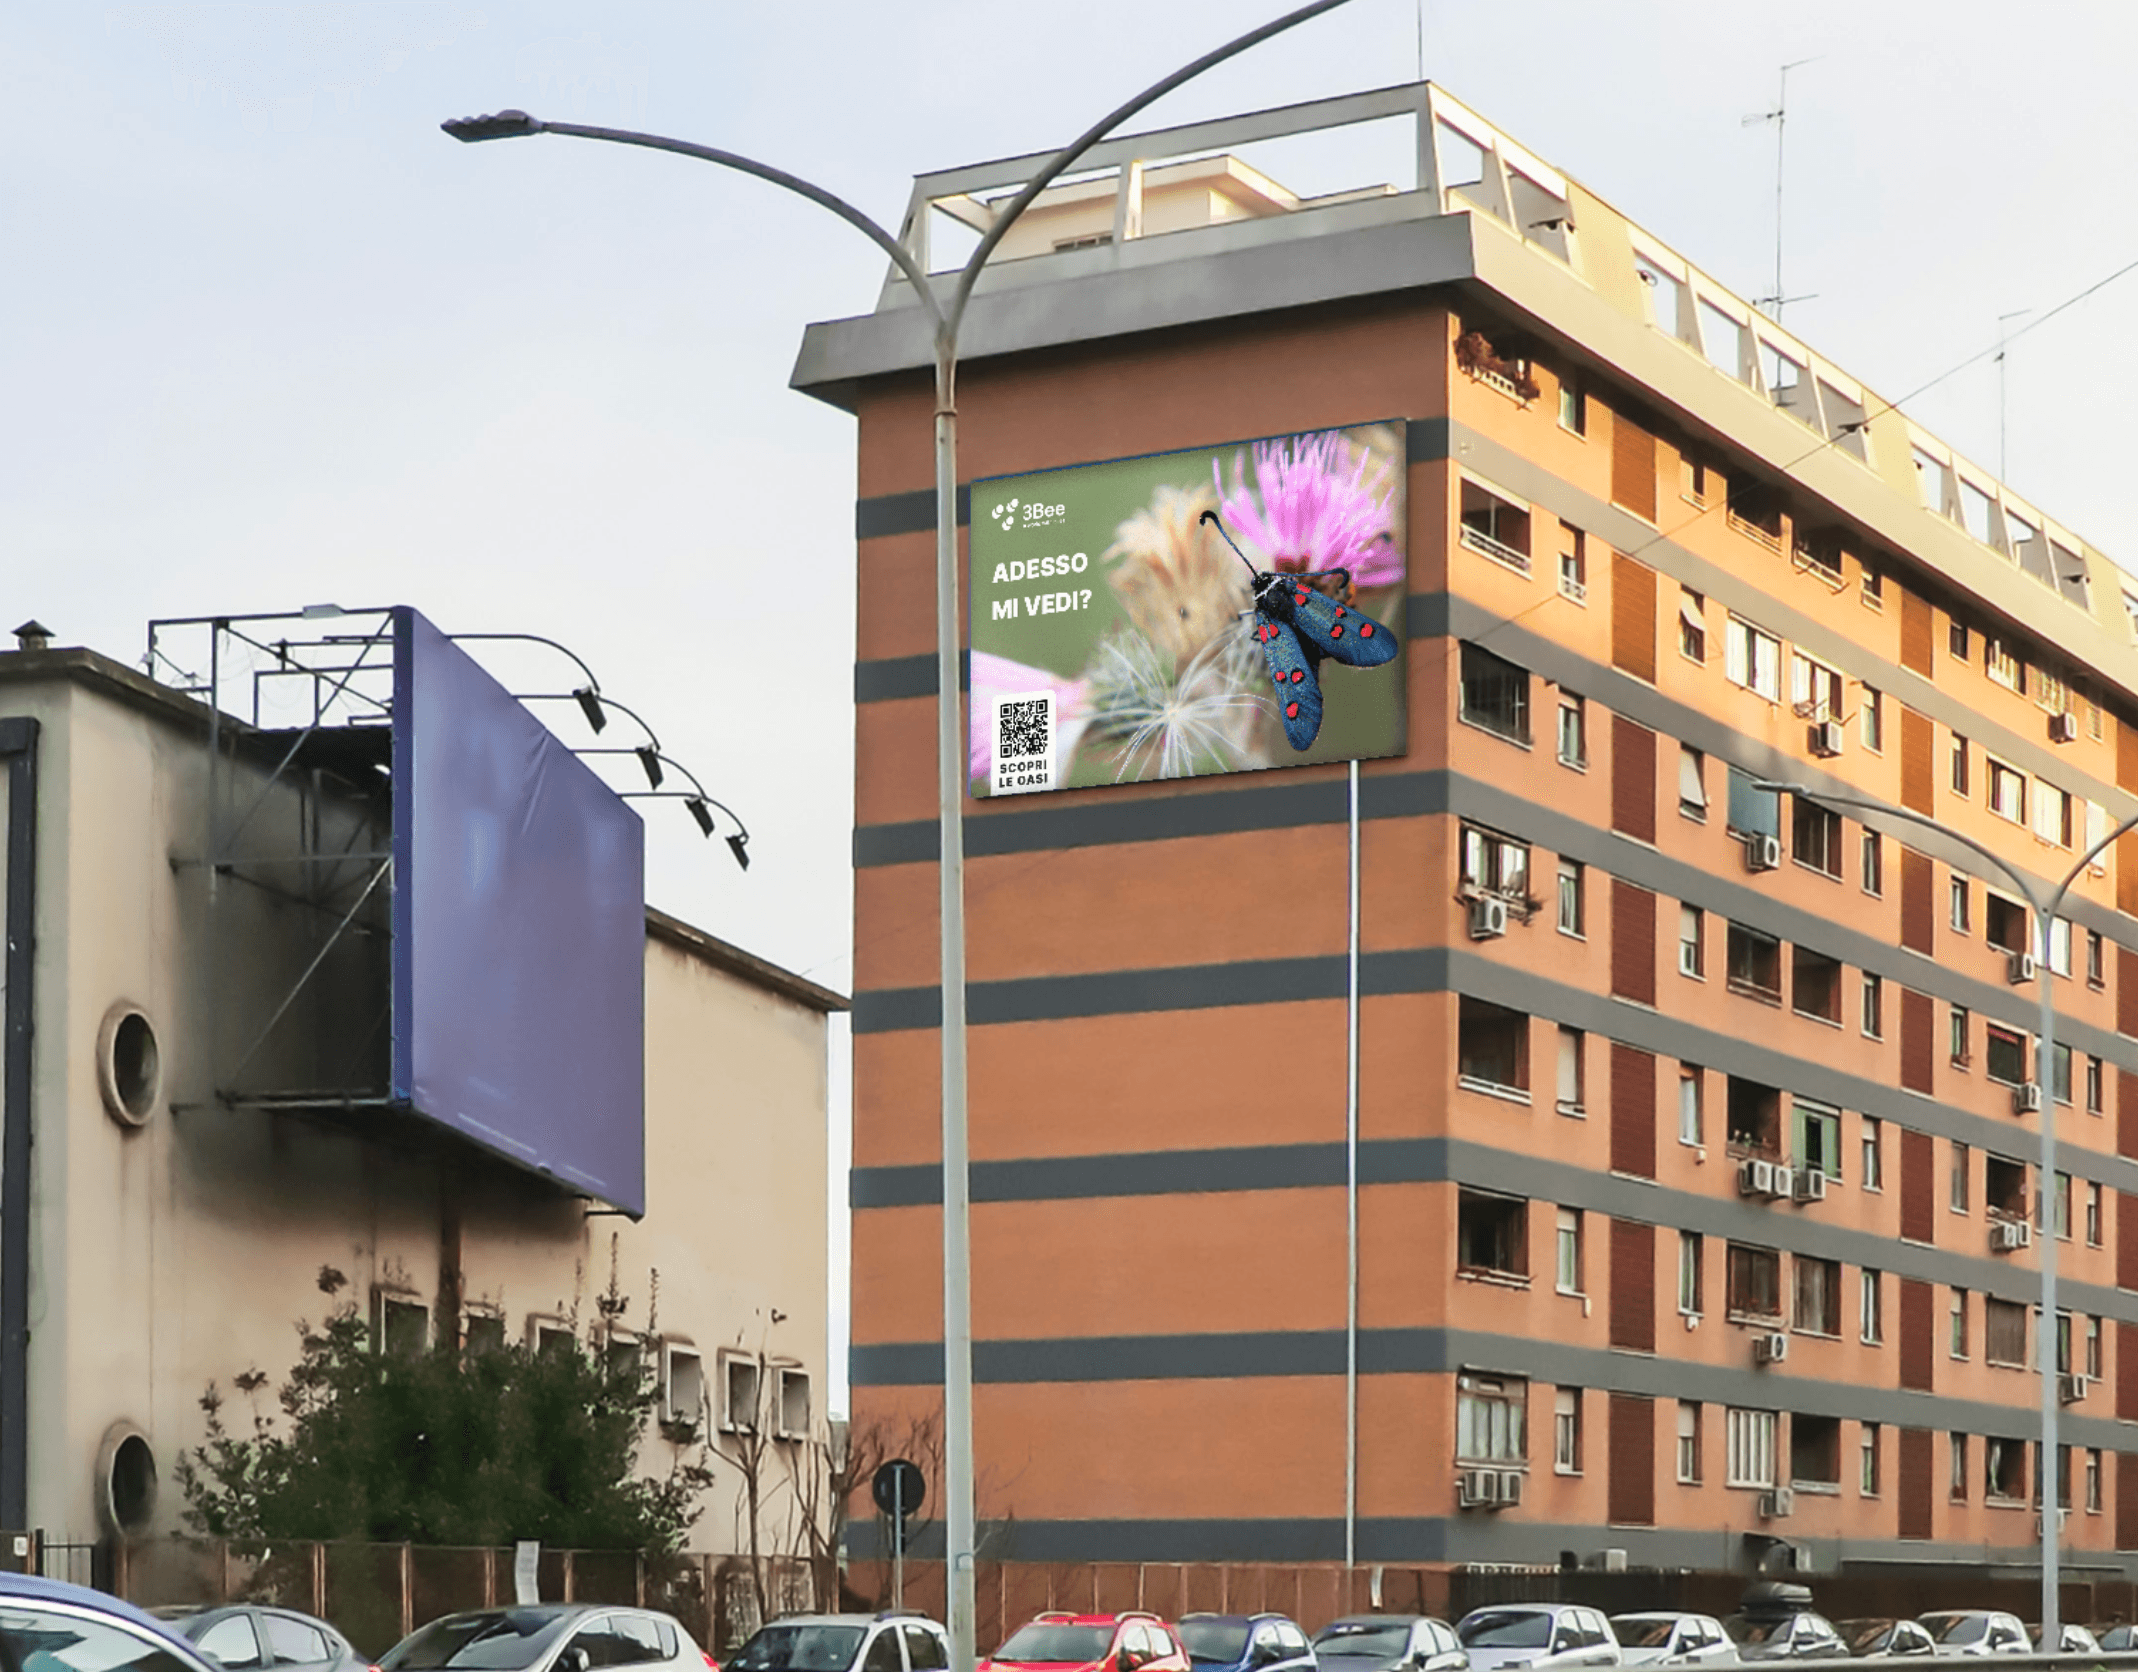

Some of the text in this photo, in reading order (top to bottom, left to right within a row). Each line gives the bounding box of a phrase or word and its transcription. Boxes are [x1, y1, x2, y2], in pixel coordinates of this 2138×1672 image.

[1023, 503, 1065, 520] 3Bee
[992, 552, 1088, 583] ADESSO
[992, 589, 1092, 621] MI VEDI?
[1000, 759, 1047, 774] SCOPRI
[999, 773, 1048, 788] LE OASI
